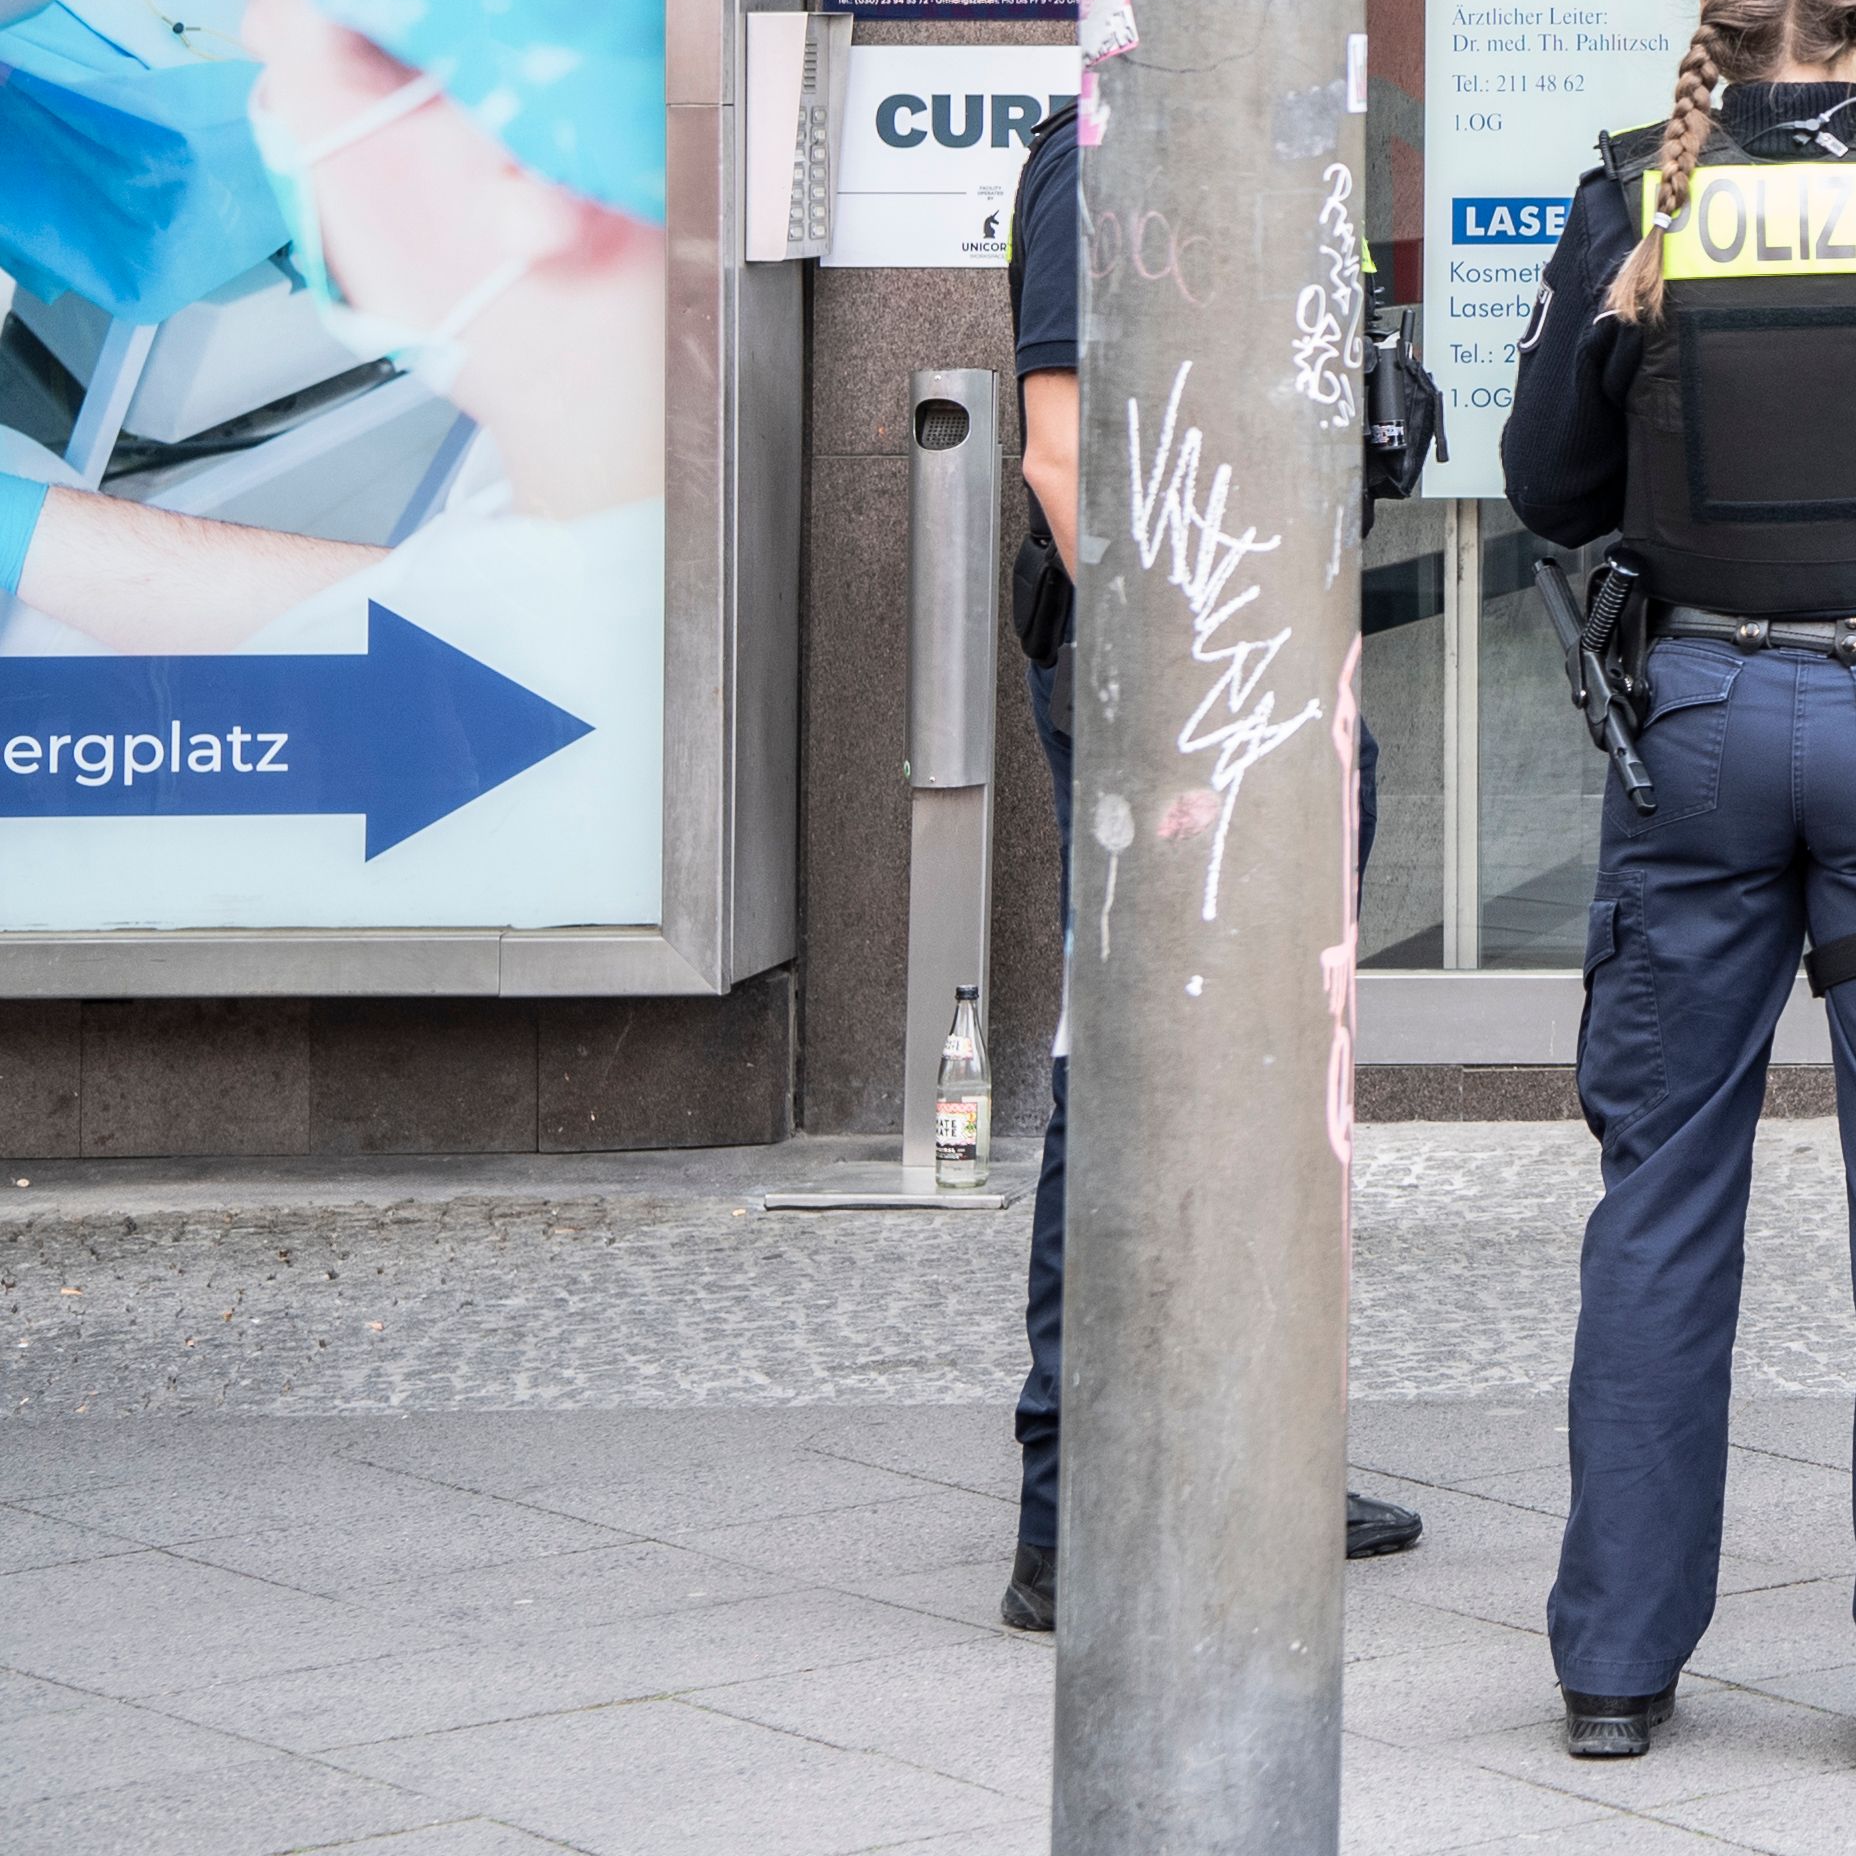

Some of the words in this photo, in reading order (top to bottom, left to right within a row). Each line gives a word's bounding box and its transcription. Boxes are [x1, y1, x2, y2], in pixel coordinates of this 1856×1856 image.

[1452, 4, 1543, 26] Ärztlicher
[1549, 7, 1609, 26] Leiter:
[1452, 35, 1480, 52] Dr.
[1487, 34, 1531, 52] med.
[1537, 34, 1569, 52] Th.
[1575, 33, 1670, 52] Pahlitzsch
[1452, 74, 1489, 93] Tel.:
[1496, 75, 1528, 93] 211
[1535, 75, 1558, 93] 48
[1563, 75, 1585, 93] 62
[1450, 344, 1494, 364] Tel.:
[3, 719, 289, 786] ergplatz
